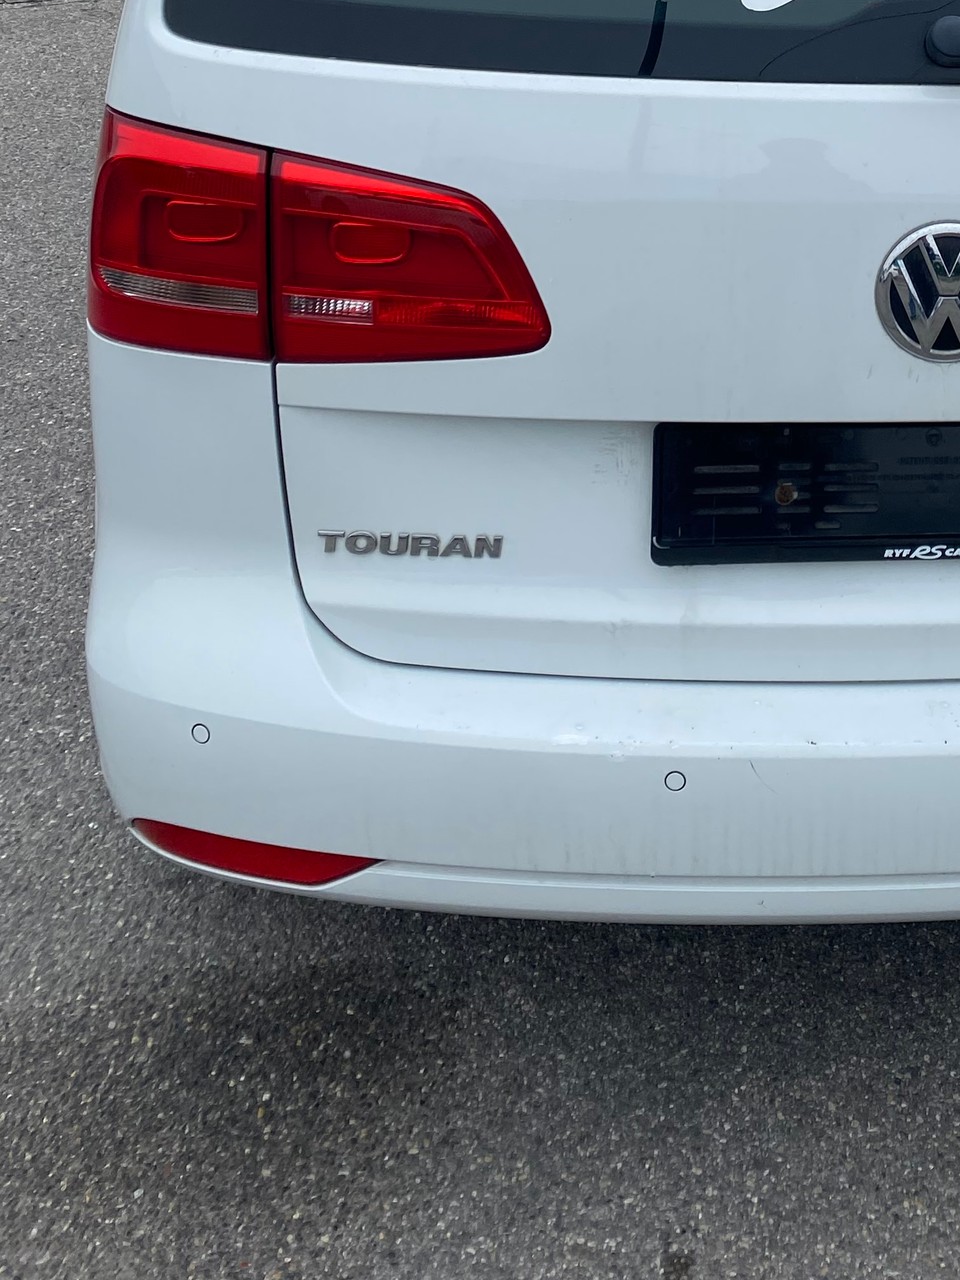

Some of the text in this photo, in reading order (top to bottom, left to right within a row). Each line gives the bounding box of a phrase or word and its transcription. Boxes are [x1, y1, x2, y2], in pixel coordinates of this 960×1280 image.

[317, 530, 504, 559] TOURAN
[883, 548, 911, 558] RYF
[909, 545, 947, 560] RS
